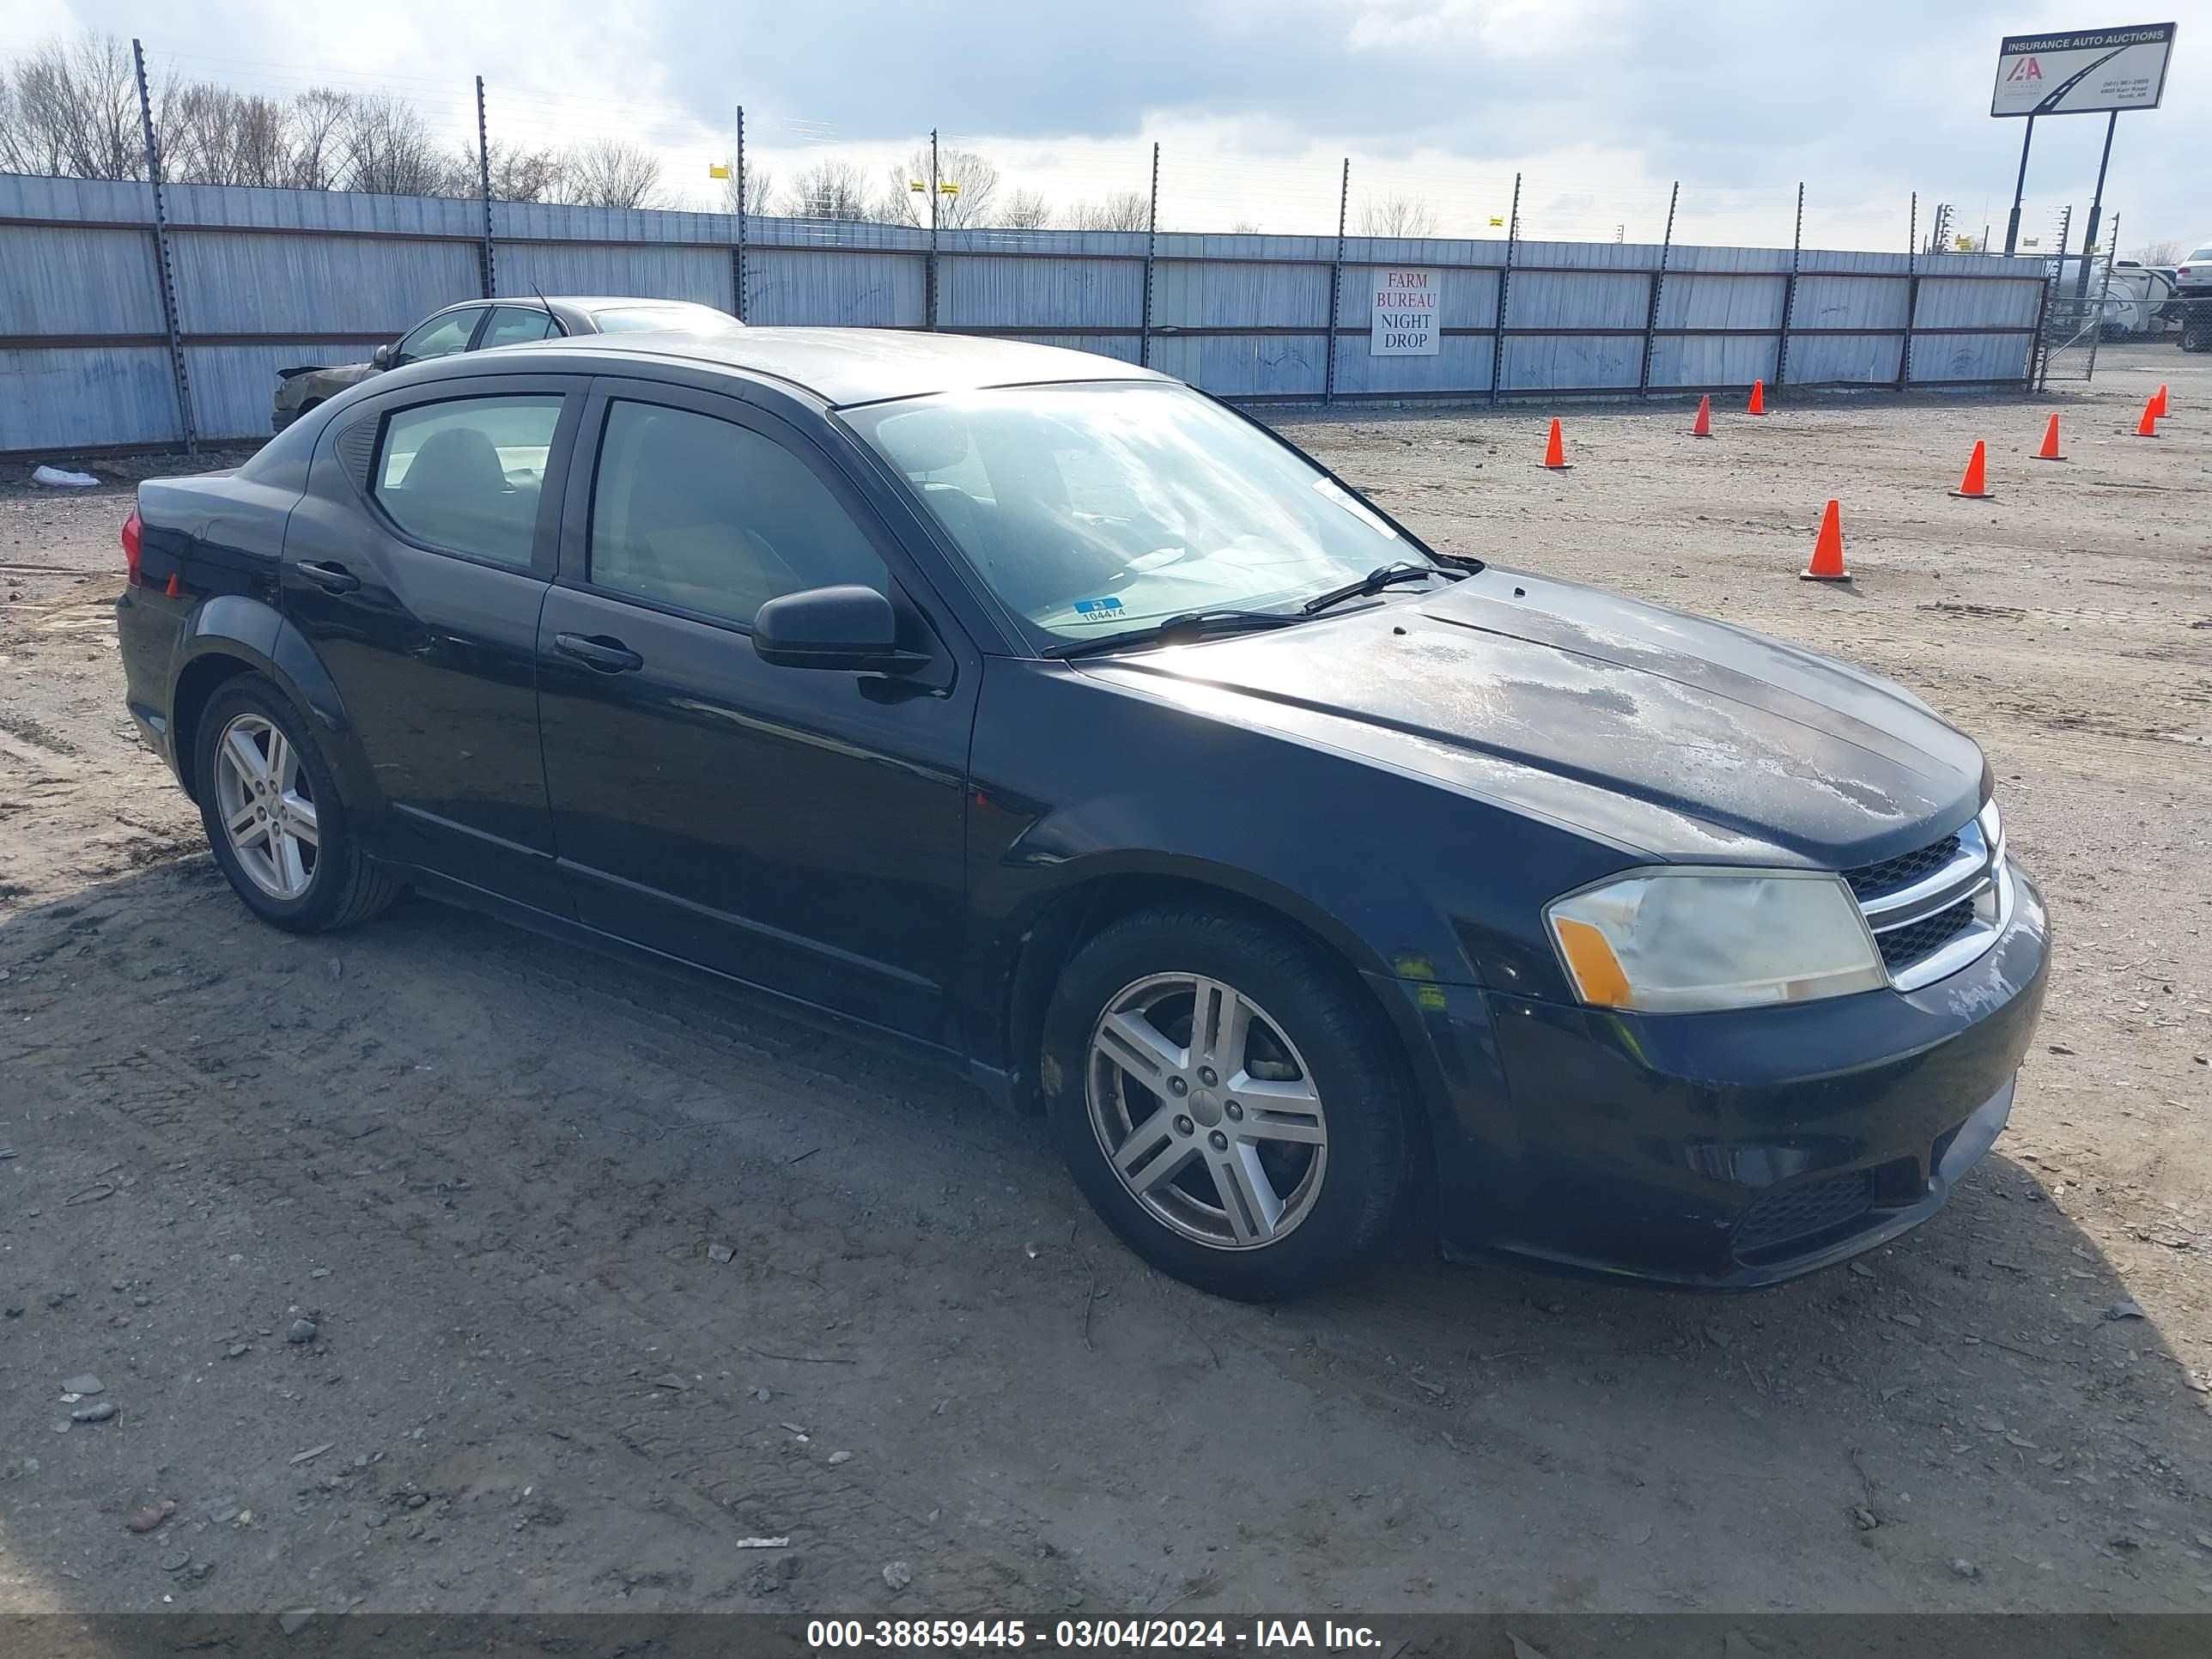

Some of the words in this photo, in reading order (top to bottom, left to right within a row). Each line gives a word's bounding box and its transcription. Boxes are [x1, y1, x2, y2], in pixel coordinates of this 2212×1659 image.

[2008, 38, 2070, 52] INSURANCE
[2072, 35, 2103, 47] AUTO
[2106, 30, 2165, 44] AUCTIONS
[1388, 272, 1428, 289] FARM
[1376, 292, 1437, 307] BUREAU
[1381, 313, 1431, 329] NIGHT
[1385, 333, 1427, 348] DROP
[1083, 608, 1126, 622] 104474
